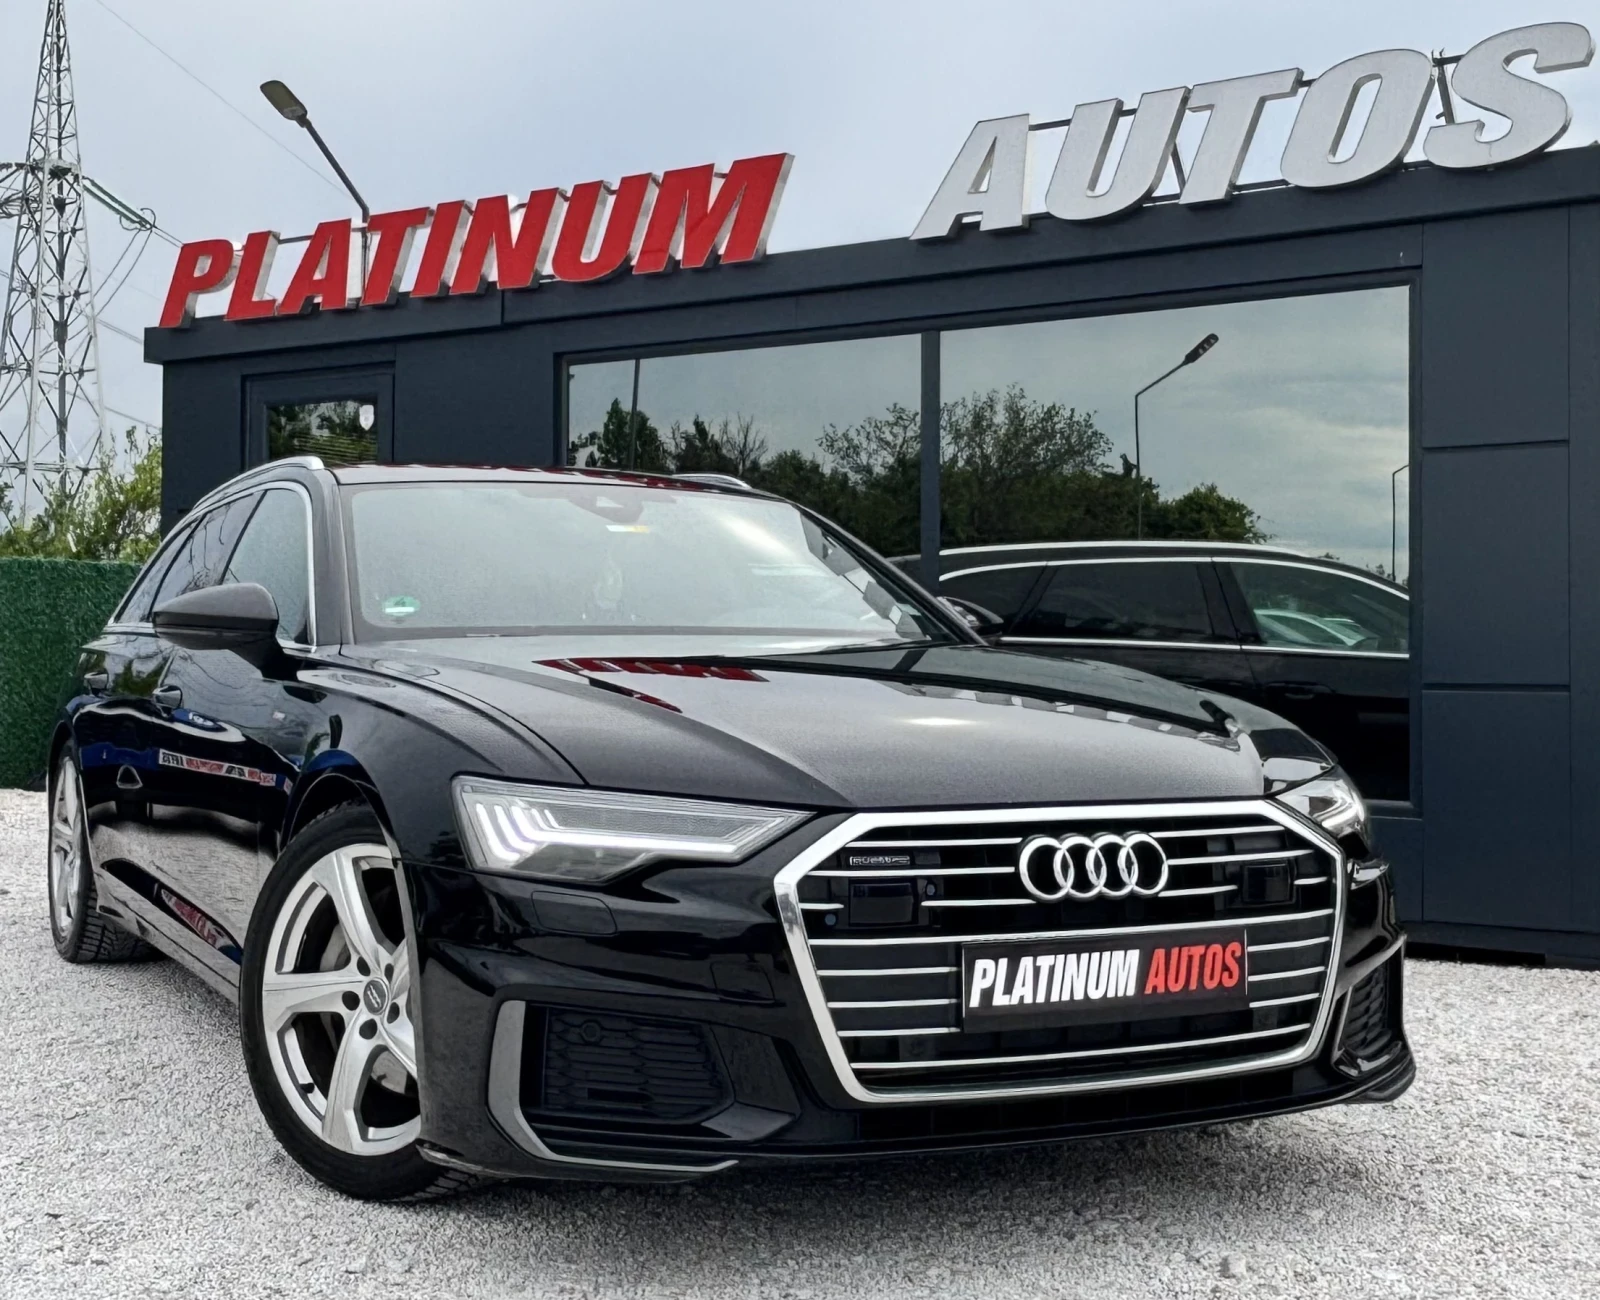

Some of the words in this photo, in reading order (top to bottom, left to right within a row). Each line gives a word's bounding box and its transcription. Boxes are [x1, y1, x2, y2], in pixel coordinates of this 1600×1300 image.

[159, 152, 794, 328] PLATINUM
[909, 22, 1595, 240] AUTOS
[968, 949, 1140, 1008] PLATINUM
[1144, 942, 1242, 994] AUTOS
